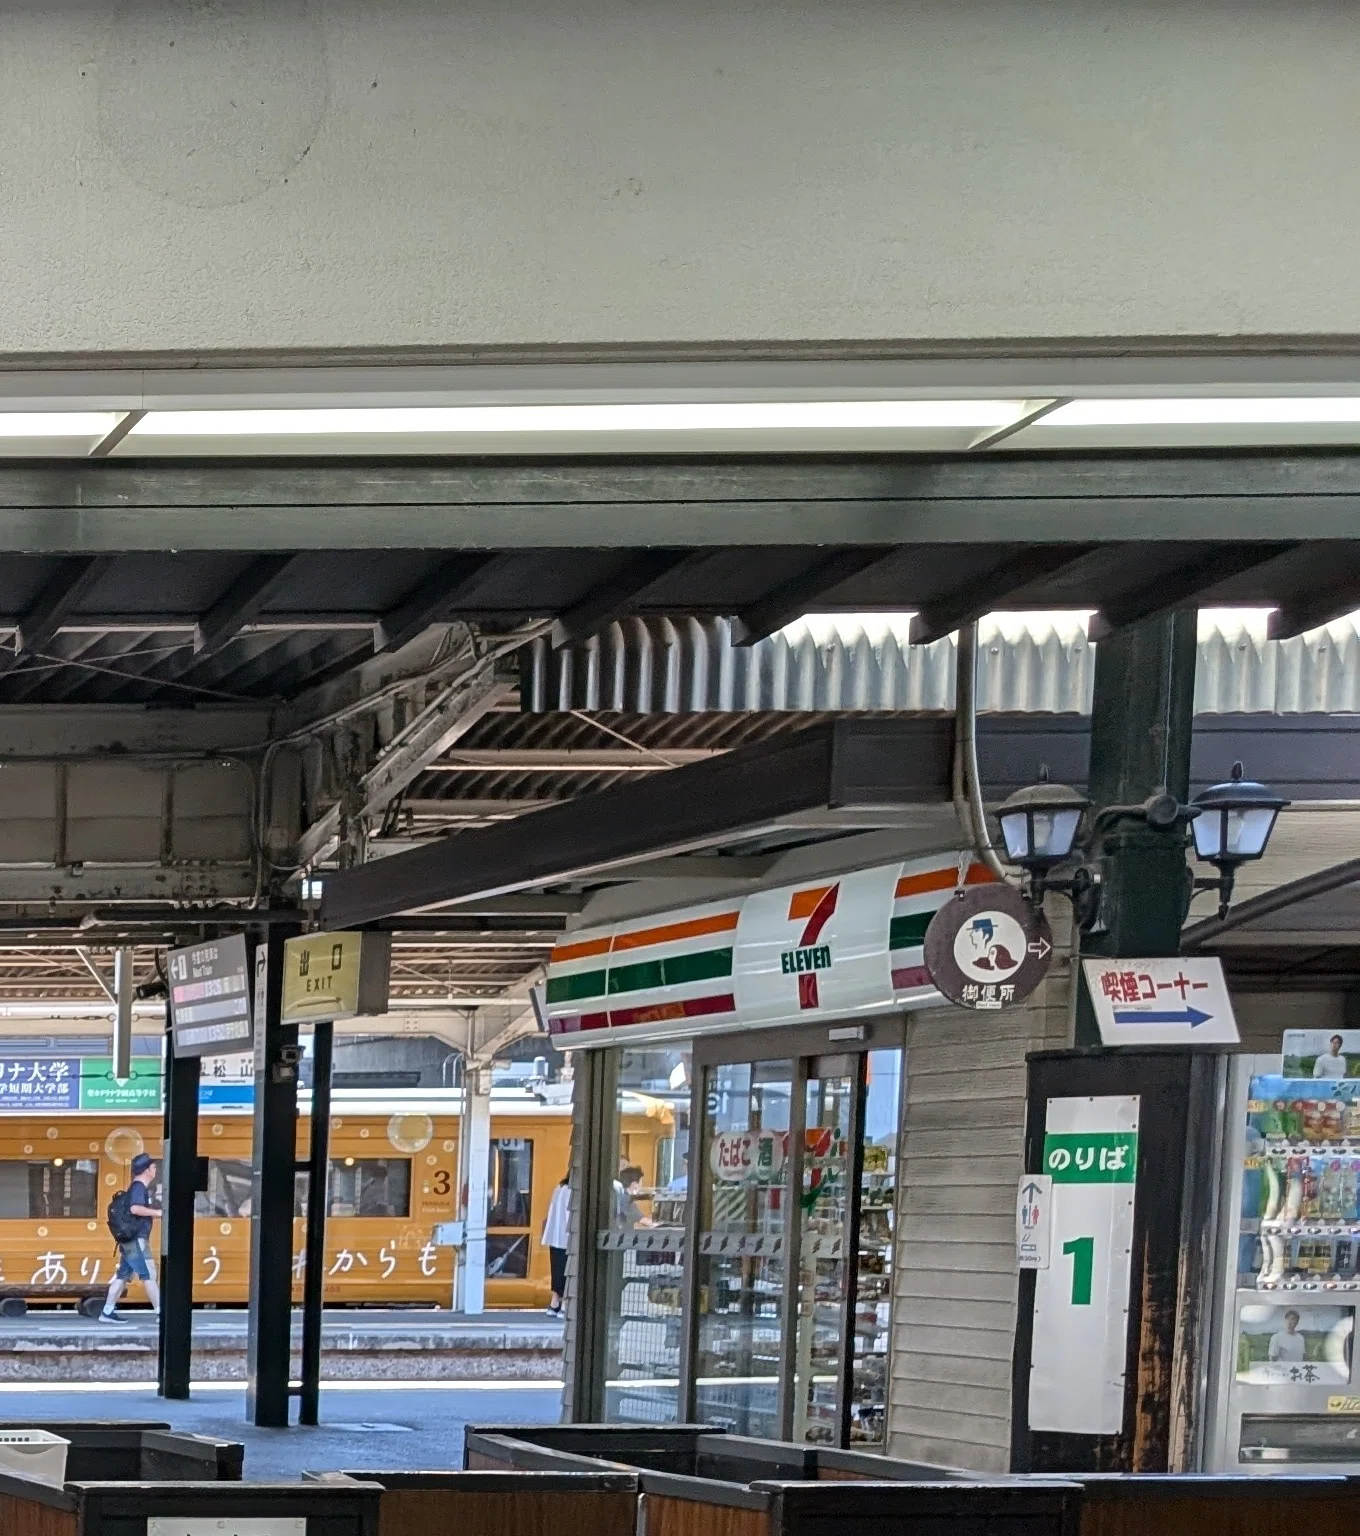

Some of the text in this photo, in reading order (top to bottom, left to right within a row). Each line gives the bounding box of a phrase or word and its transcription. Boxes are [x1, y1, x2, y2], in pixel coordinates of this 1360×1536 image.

[306, 975, 333, 992] EXIT
[962, 984, 1015, 1001] 御便所
[1101, 971, 1208, 1002] 喫煙コーナー
[1048, 1145, 1129, 1171] のりば
[434, 1170, 450, 1195] 3
[1062, 1237, 1094, 1305] 1
